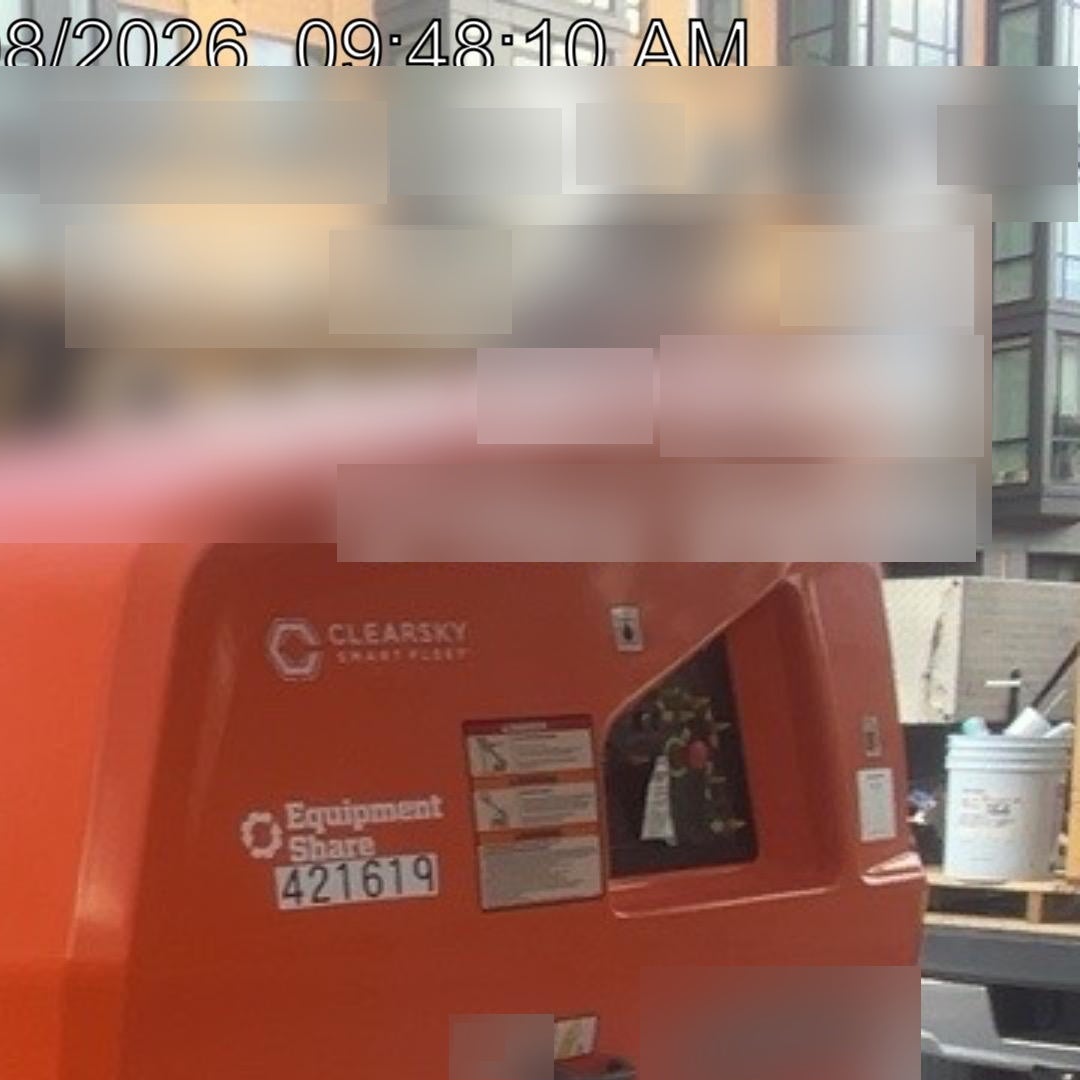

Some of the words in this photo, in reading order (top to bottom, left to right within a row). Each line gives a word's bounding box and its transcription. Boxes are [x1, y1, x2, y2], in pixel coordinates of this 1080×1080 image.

[328, 622, 468, 645] CLEARSKY
[284, 795, 443, 833] Equipment
[289, 834, 375, 862] Share
[282, 855, 433, 904] 421619
